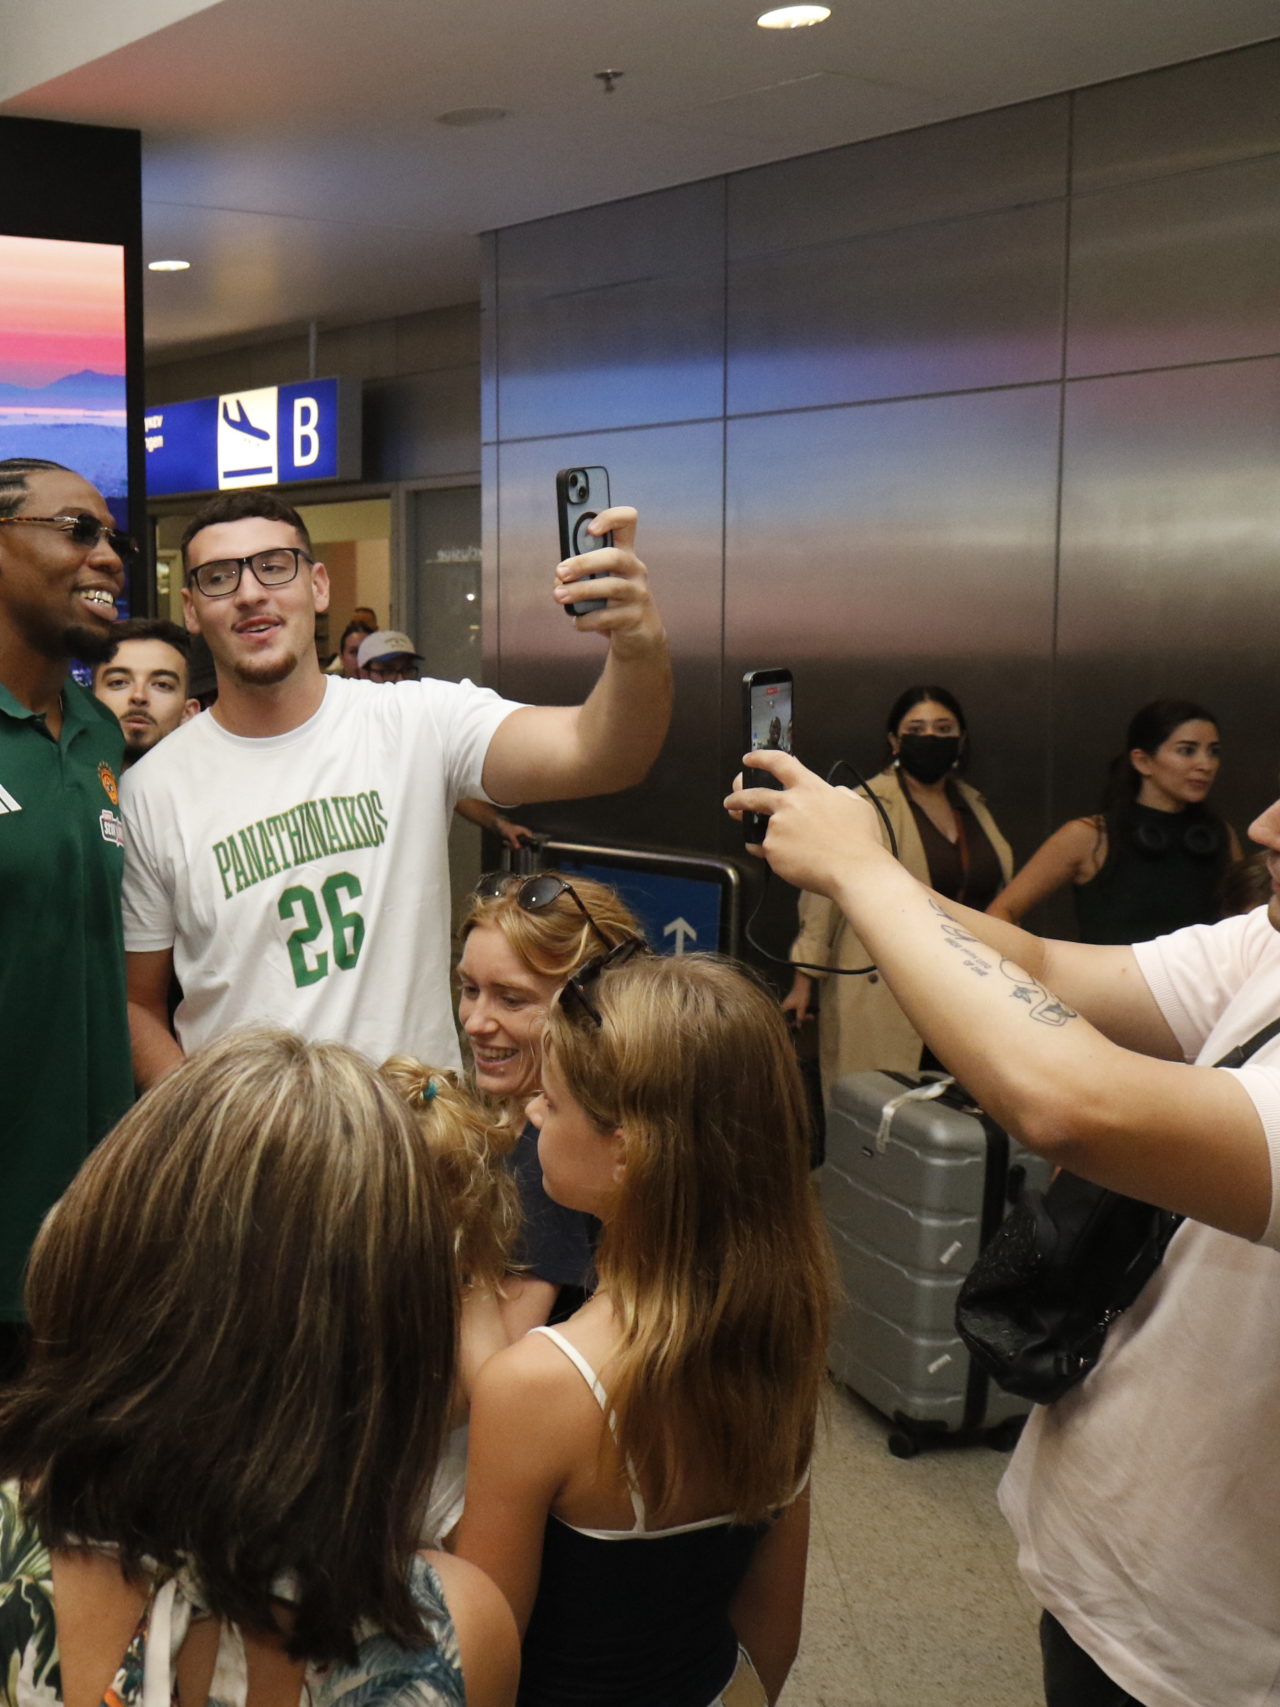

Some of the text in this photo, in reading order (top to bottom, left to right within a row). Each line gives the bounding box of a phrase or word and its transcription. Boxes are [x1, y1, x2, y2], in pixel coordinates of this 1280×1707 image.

[293, 396, 320, 467] B
[212, 789, 388, 900] PANATHINAIKOS
[277, 871, 366, 989] 26
